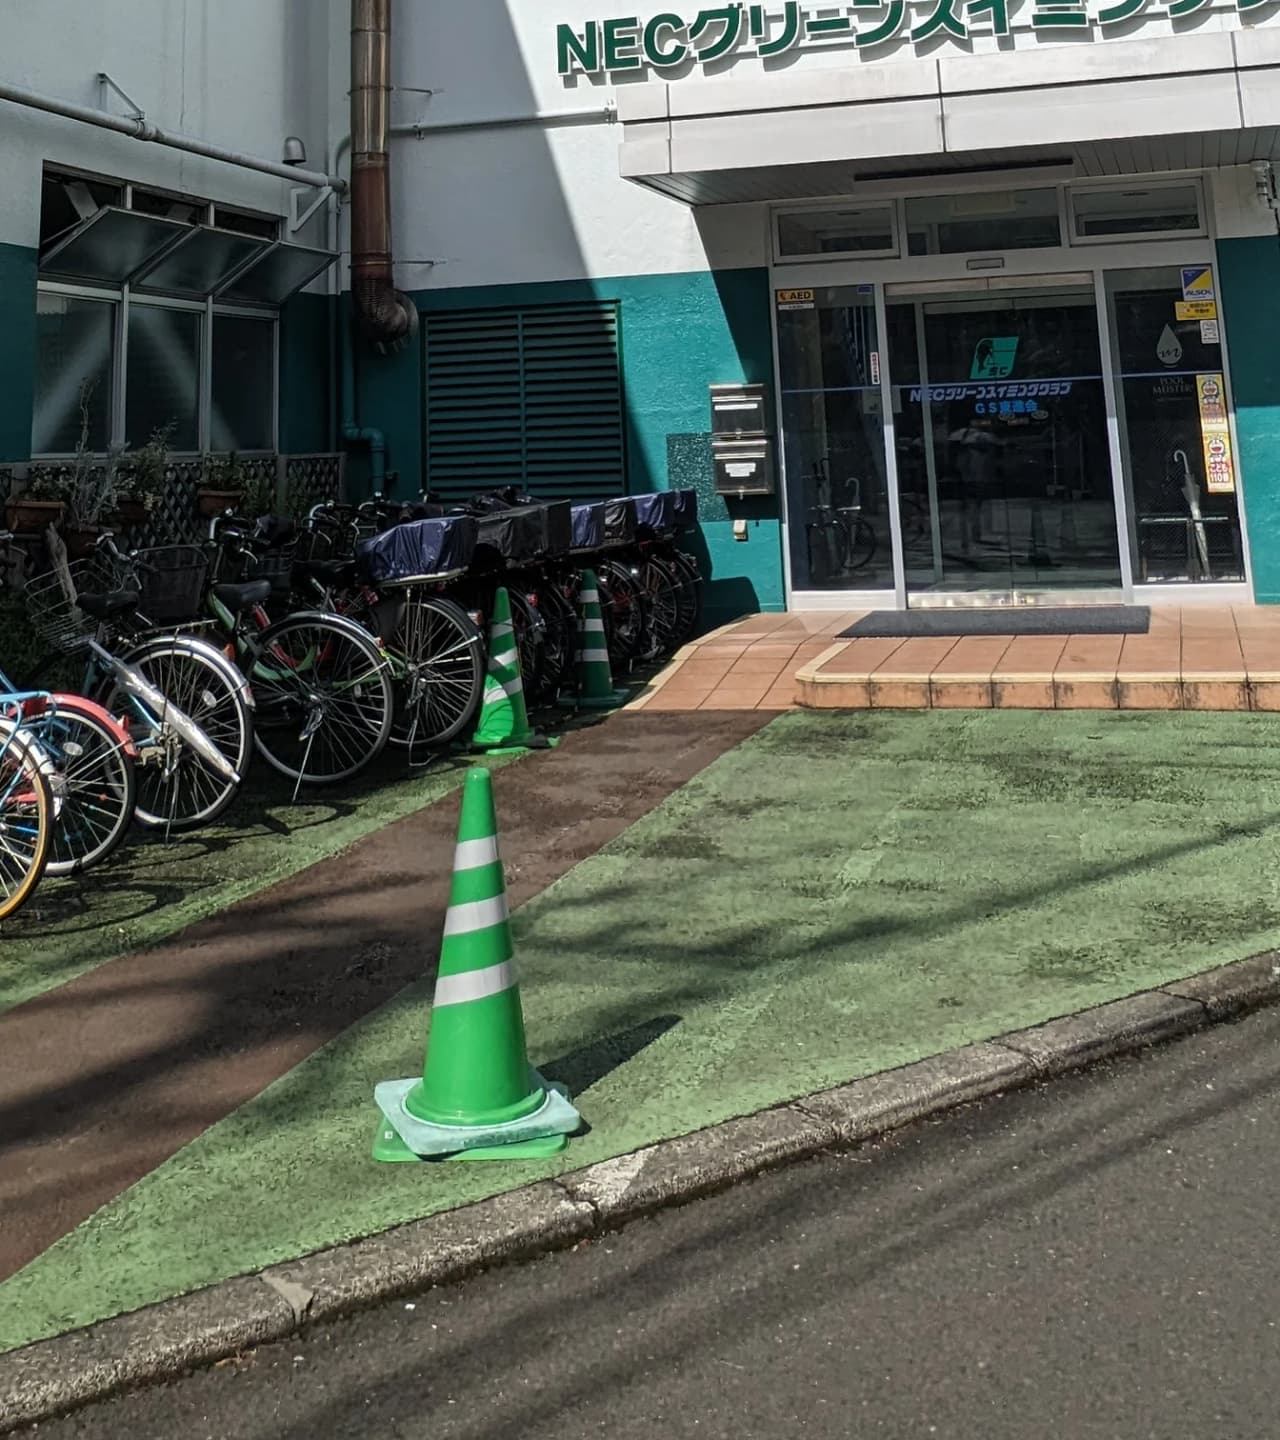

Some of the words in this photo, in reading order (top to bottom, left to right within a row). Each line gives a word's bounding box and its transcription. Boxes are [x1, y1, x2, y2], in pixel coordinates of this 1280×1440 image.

[790, 291, 811, 300] AED
[910, 382, 1072, 402] NECグリーンスイミングクラブ
